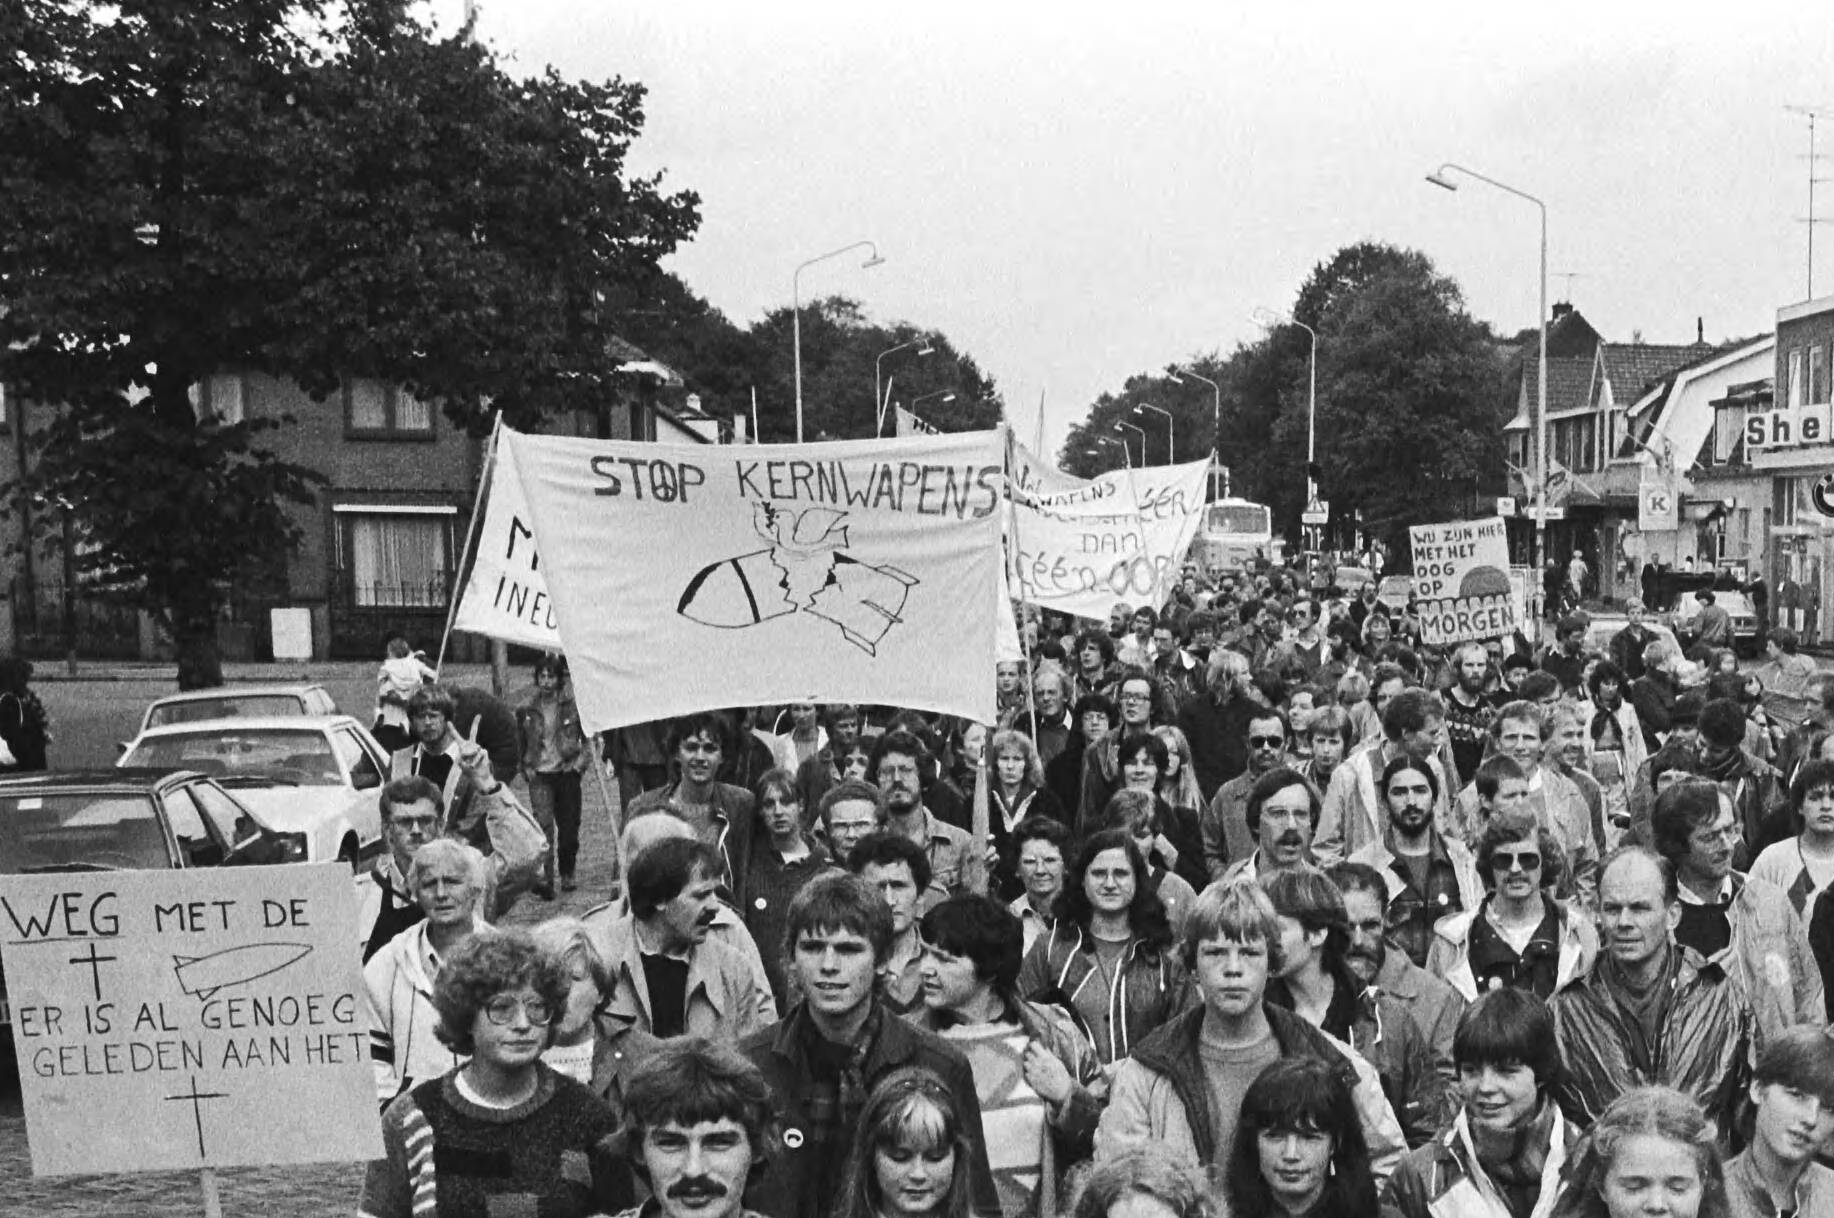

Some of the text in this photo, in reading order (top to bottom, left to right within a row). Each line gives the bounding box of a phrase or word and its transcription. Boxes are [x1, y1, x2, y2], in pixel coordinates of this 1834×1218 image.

[590, 455, 706, 503] STOP
[735, 460, 1002, 520] KERNWAPENS
[1651, 496, 1668, 511] K
[1477, 523, 1505, 539] HIER
[1414, 543, 1476, 561] MET HET
[1416, 562, 1456, 578] OOG
[1420, 580, 1443, 596] OP
[1420, 605, 1515, 638] MORGEN
[1, 892, 310, 938] WEG MET DE
[20, 993, 356, 1036] ER IS AL GENOEG
[32, 1032, 369, 1077] GELEDEN AAN HET
